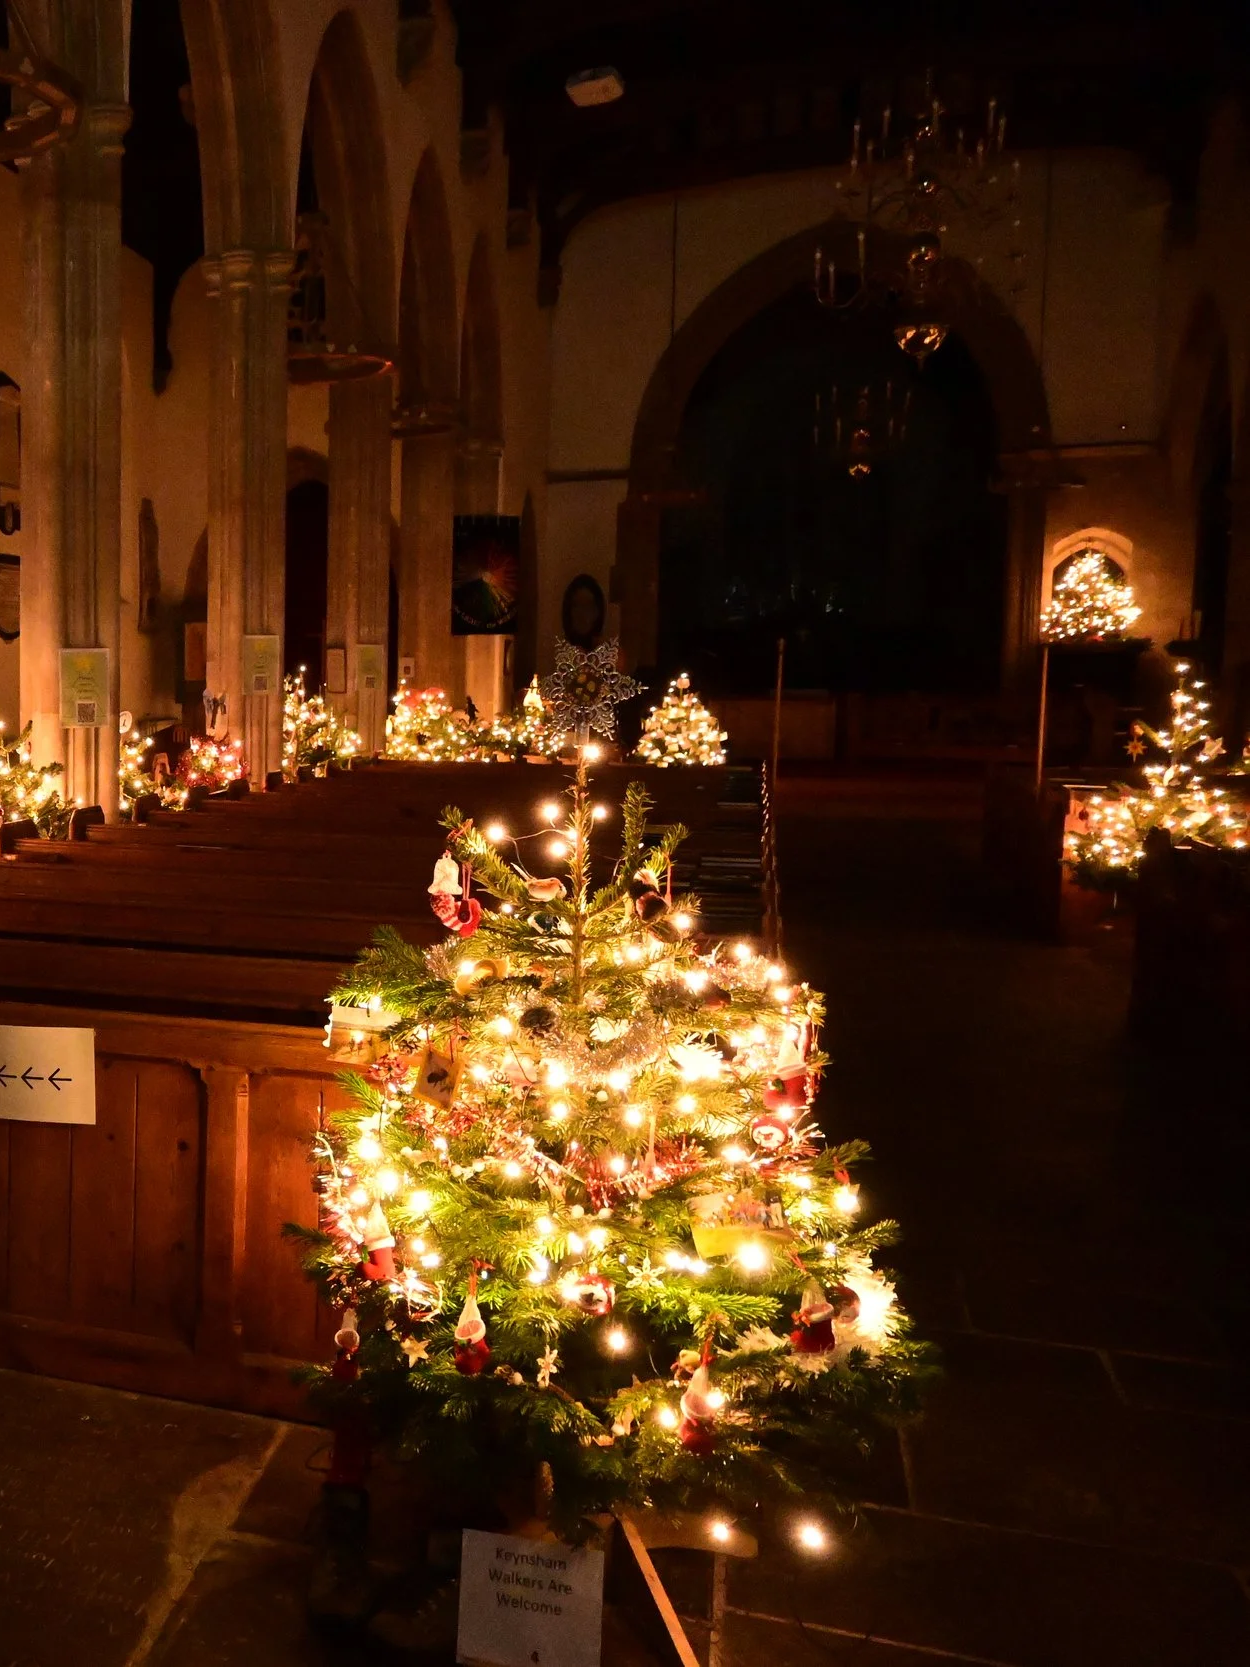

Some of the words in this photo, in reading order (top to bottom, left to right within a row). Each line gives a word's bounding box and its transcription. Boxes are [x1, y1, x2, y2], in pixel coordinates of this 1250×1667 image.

[495, 1548, 567, 1571] Keynsham
[488, 1568, 544, 1589] Walkers
[548, 1579, 573, 1595] Are
[496, 1592, 563, 1616] Welcome
